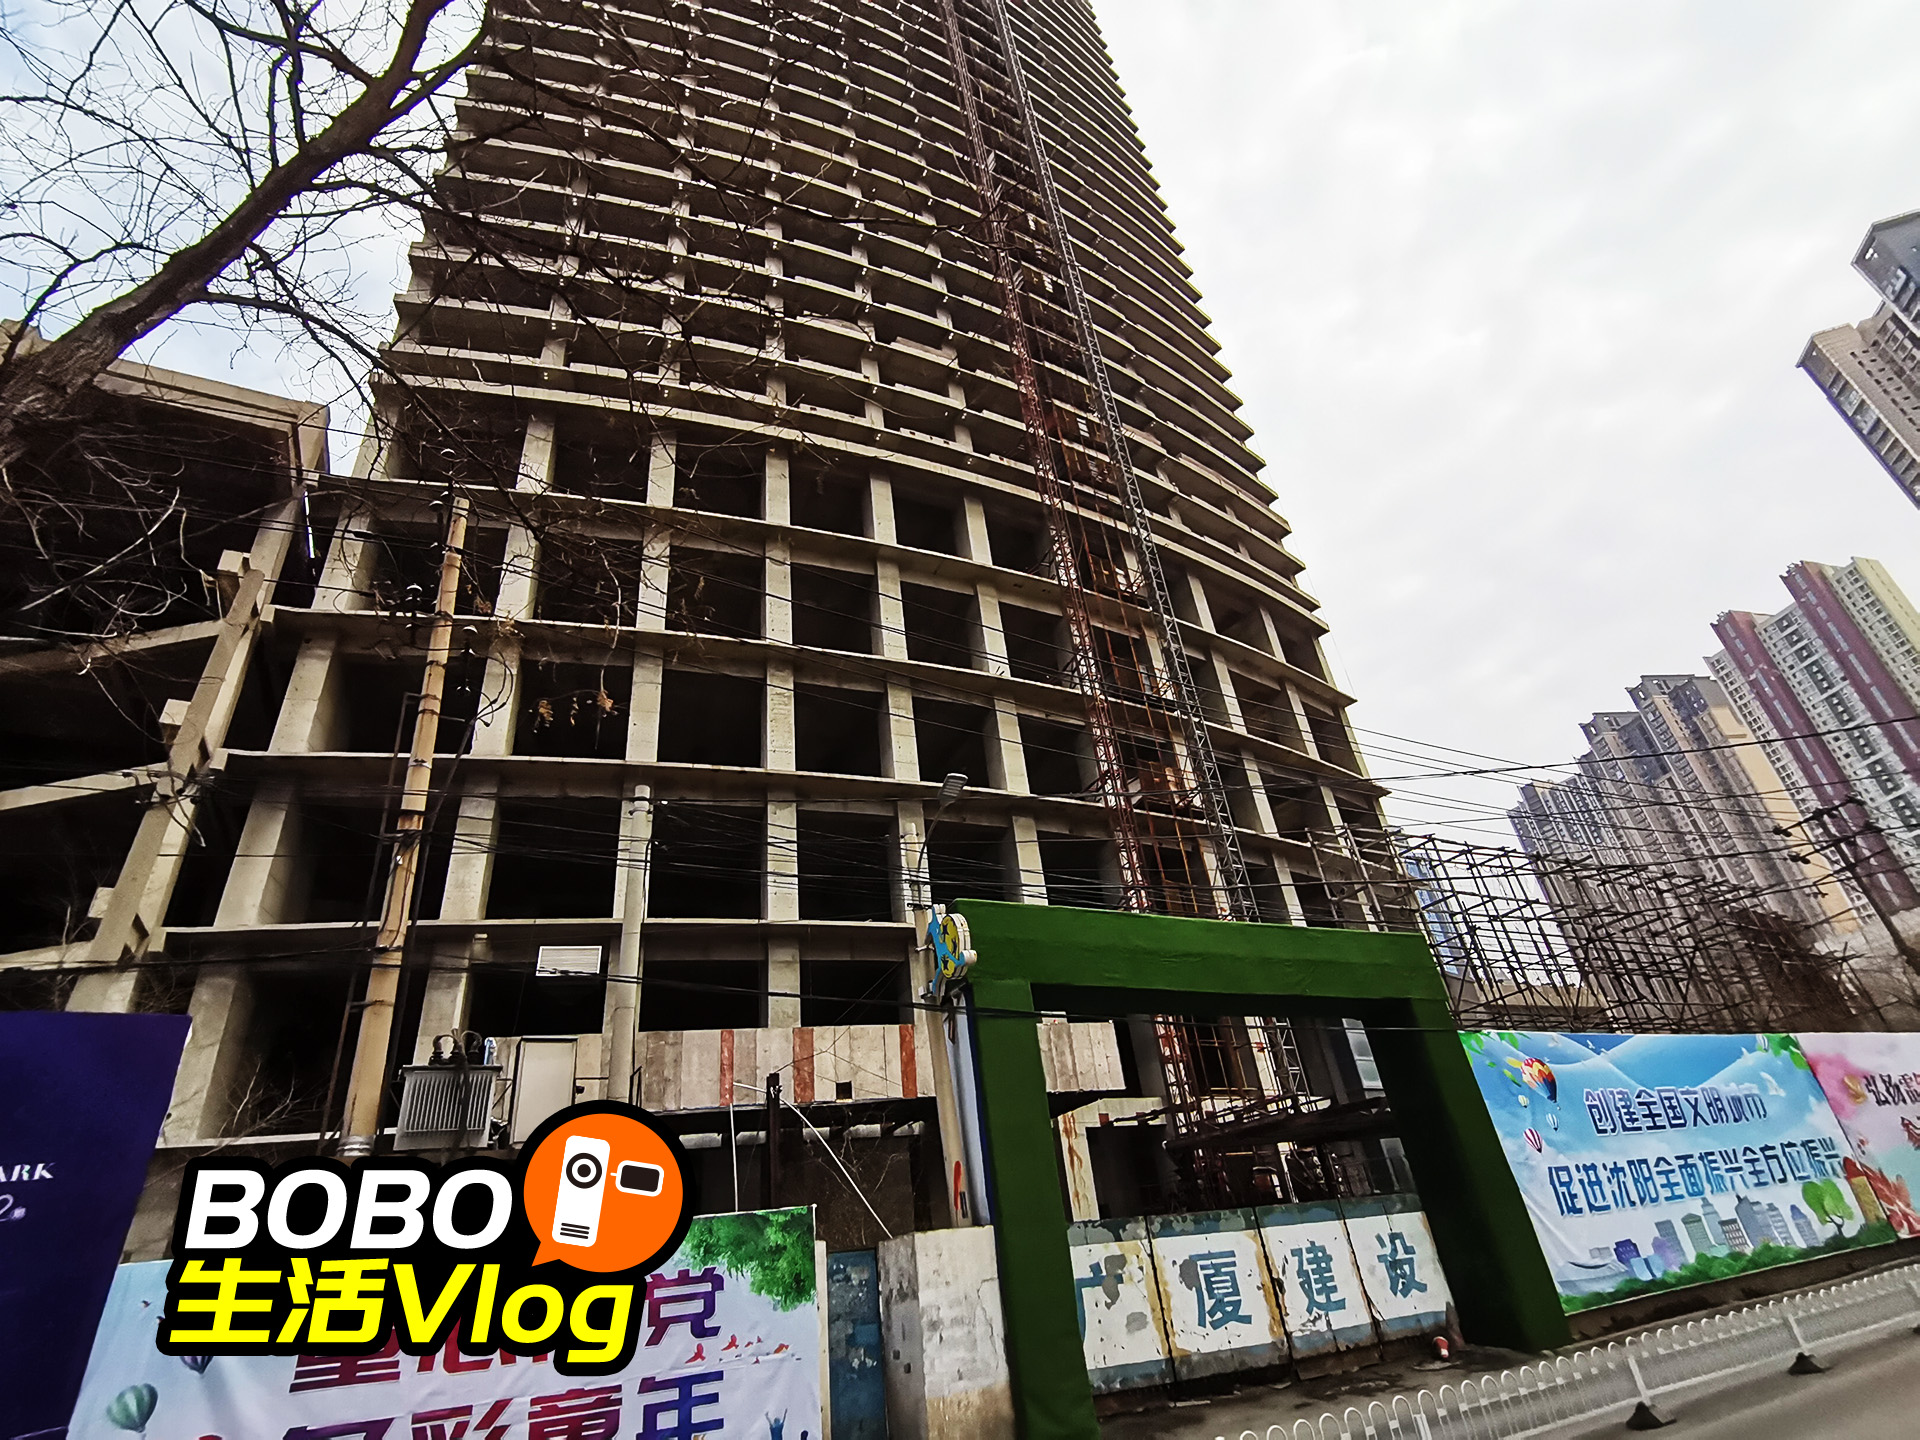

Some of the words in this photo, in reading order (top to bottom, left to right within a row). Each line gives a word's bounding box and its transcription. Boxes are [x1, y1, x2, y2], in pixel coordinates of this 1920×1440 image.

[1584, 1086, 1768, 1135] 创建全国文明城市
[1863, 1072, 1920, 1107] 弘扬雷
[1548, 1137, 1844, 1216] 促进沈阳全面振兴全方位振兴
[283, 1370, 724, 1440] 童年
